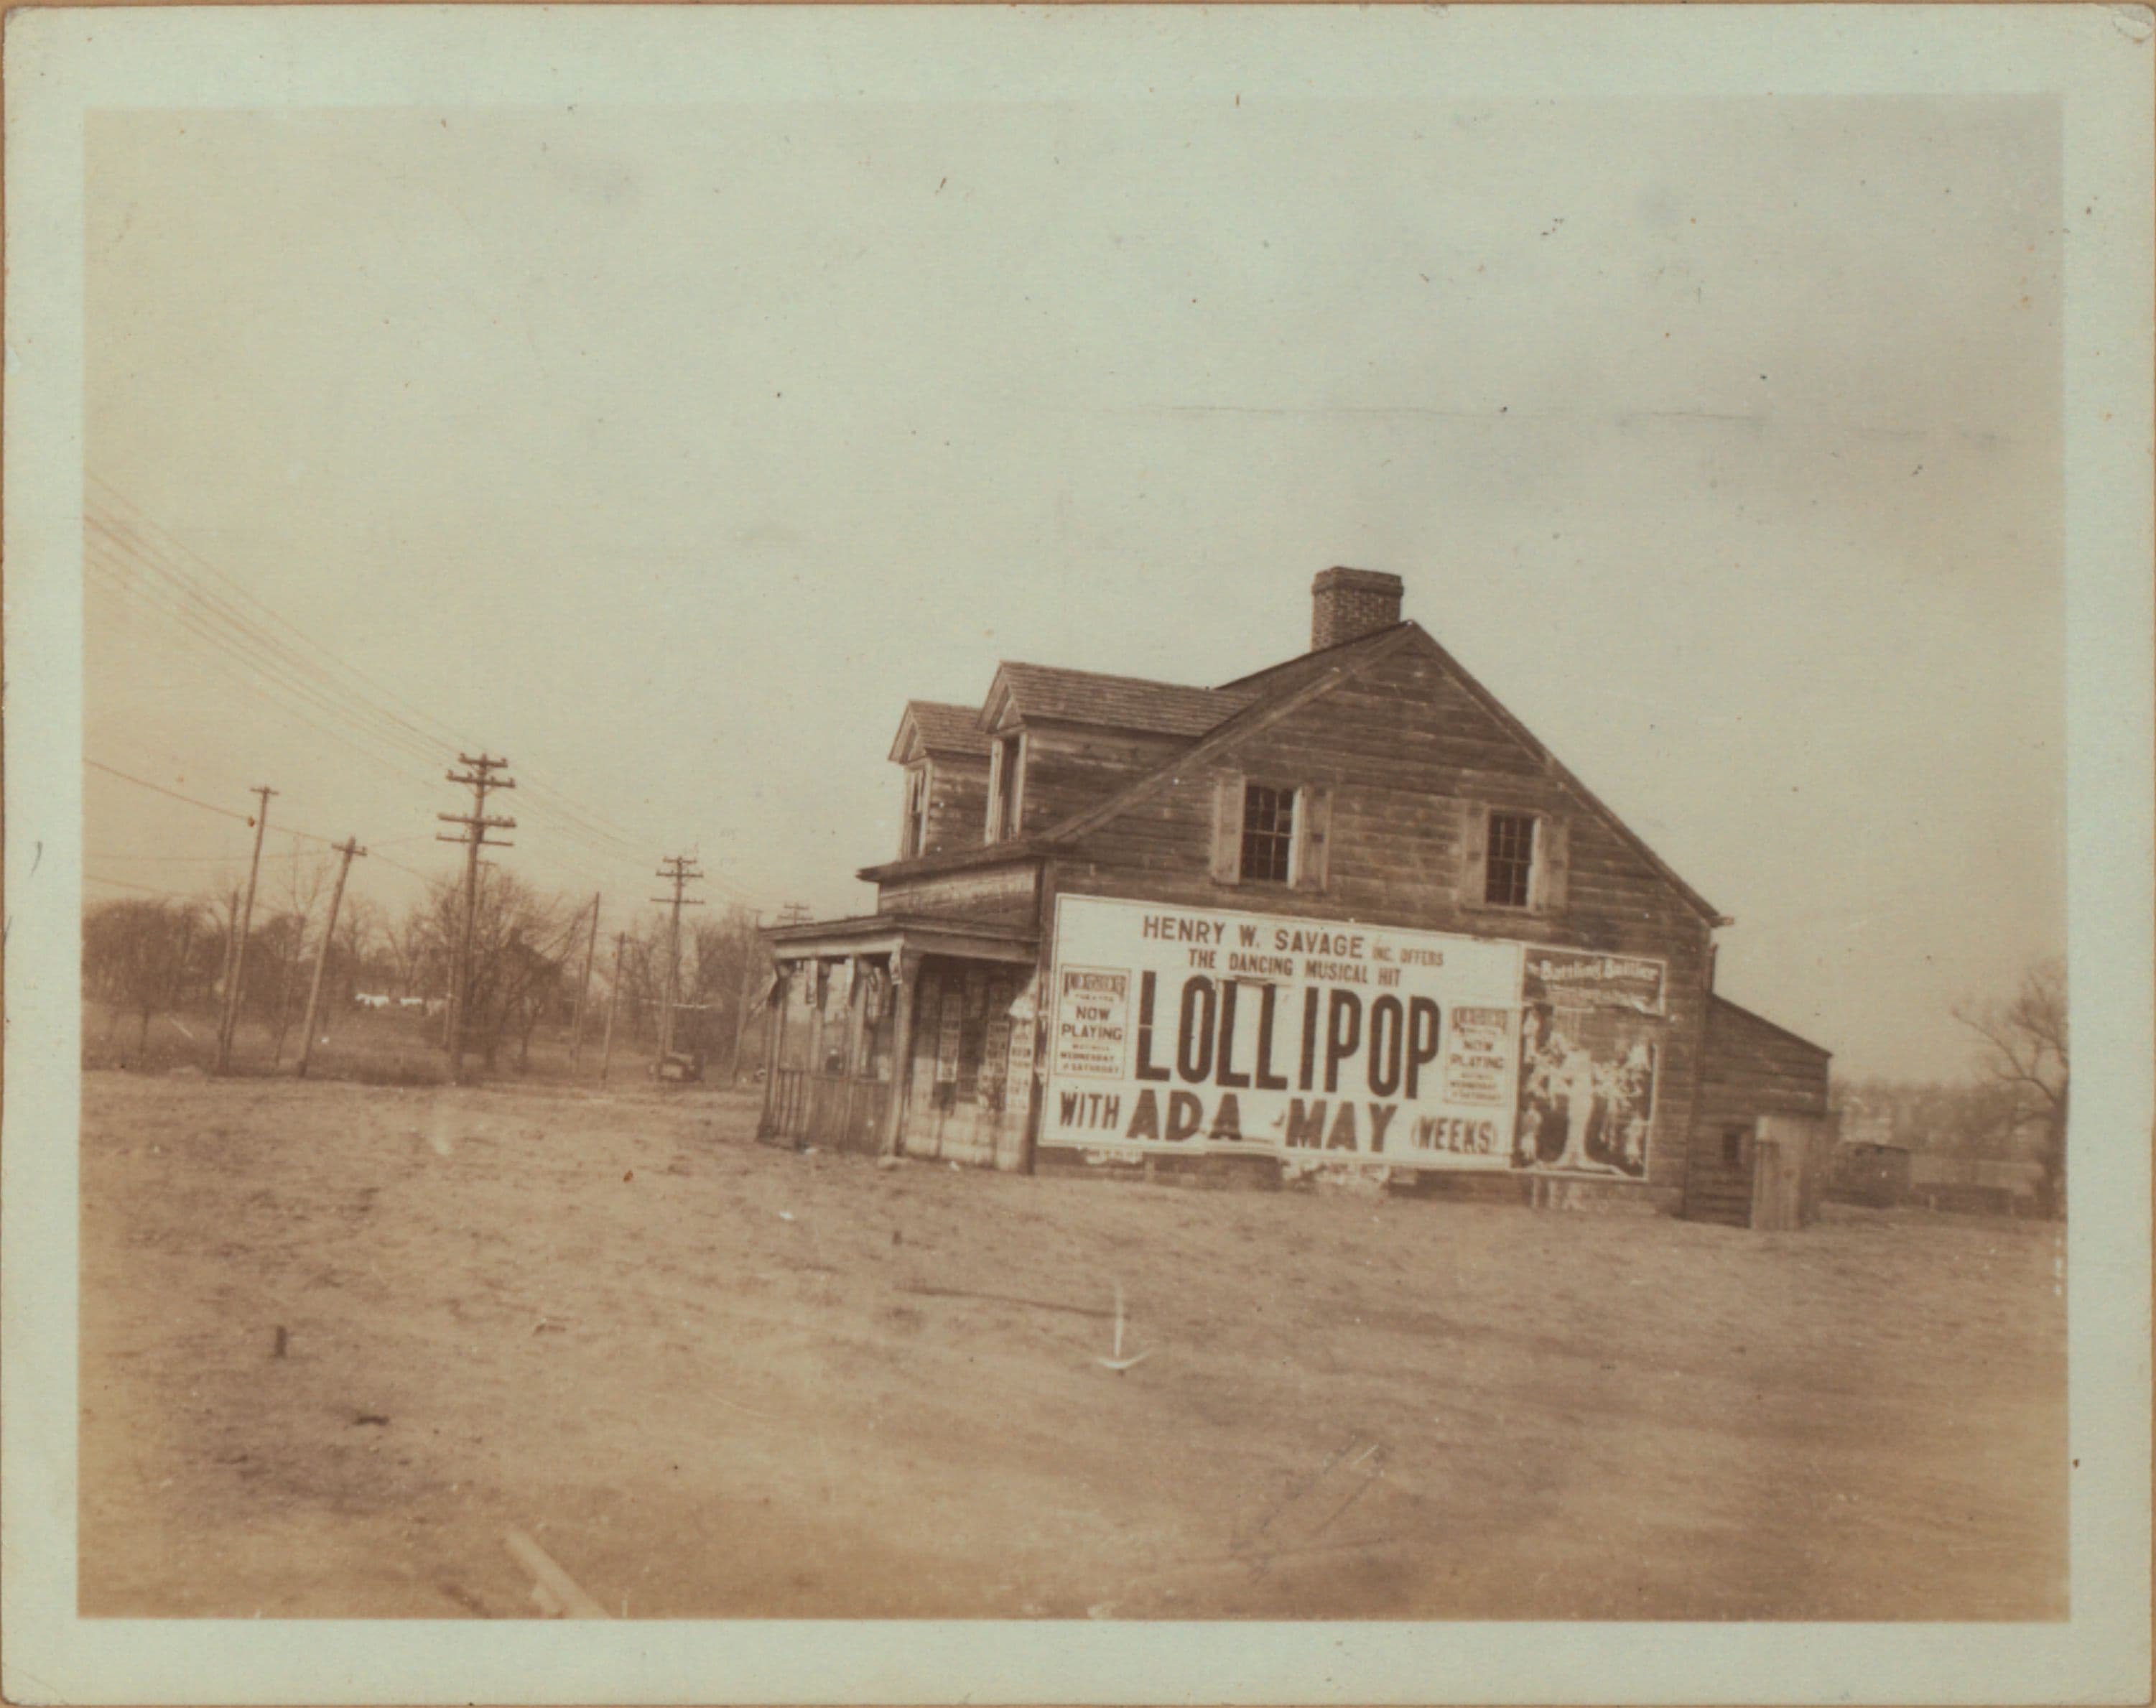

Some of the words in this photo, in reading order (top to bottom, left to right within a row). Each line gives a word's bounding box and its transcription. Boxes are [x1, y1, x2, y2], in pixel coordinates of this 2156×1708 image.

[1143, 915, 1225, 944] HENRY
[1239, 925, 1260, 947] W.
[1275, 929, 1365, 959] SAVAGE
[1400, 948, 1444, 966] OFFERS
[1189, 949, 1216, 969] THE
[1229, 952, 1293, 977] DANCING
[1305, 960, 1368, 985] MUSICAL
[1377, 967, 1400, 988] HIT
[1061, 1024, 1123, 1041] PLAYING
[1075, 1006, 1110, 1021] NOW
[1135, 970, 1441, 1100] LOLLIPOP
[1450, 1054, 1505, 1069] PLAYING
[1059, 1090, 1120, 1130] WITH
[1126, 1089, 1242, 1141] ADA
[1286, 1097, 1399, 1153] MAY
